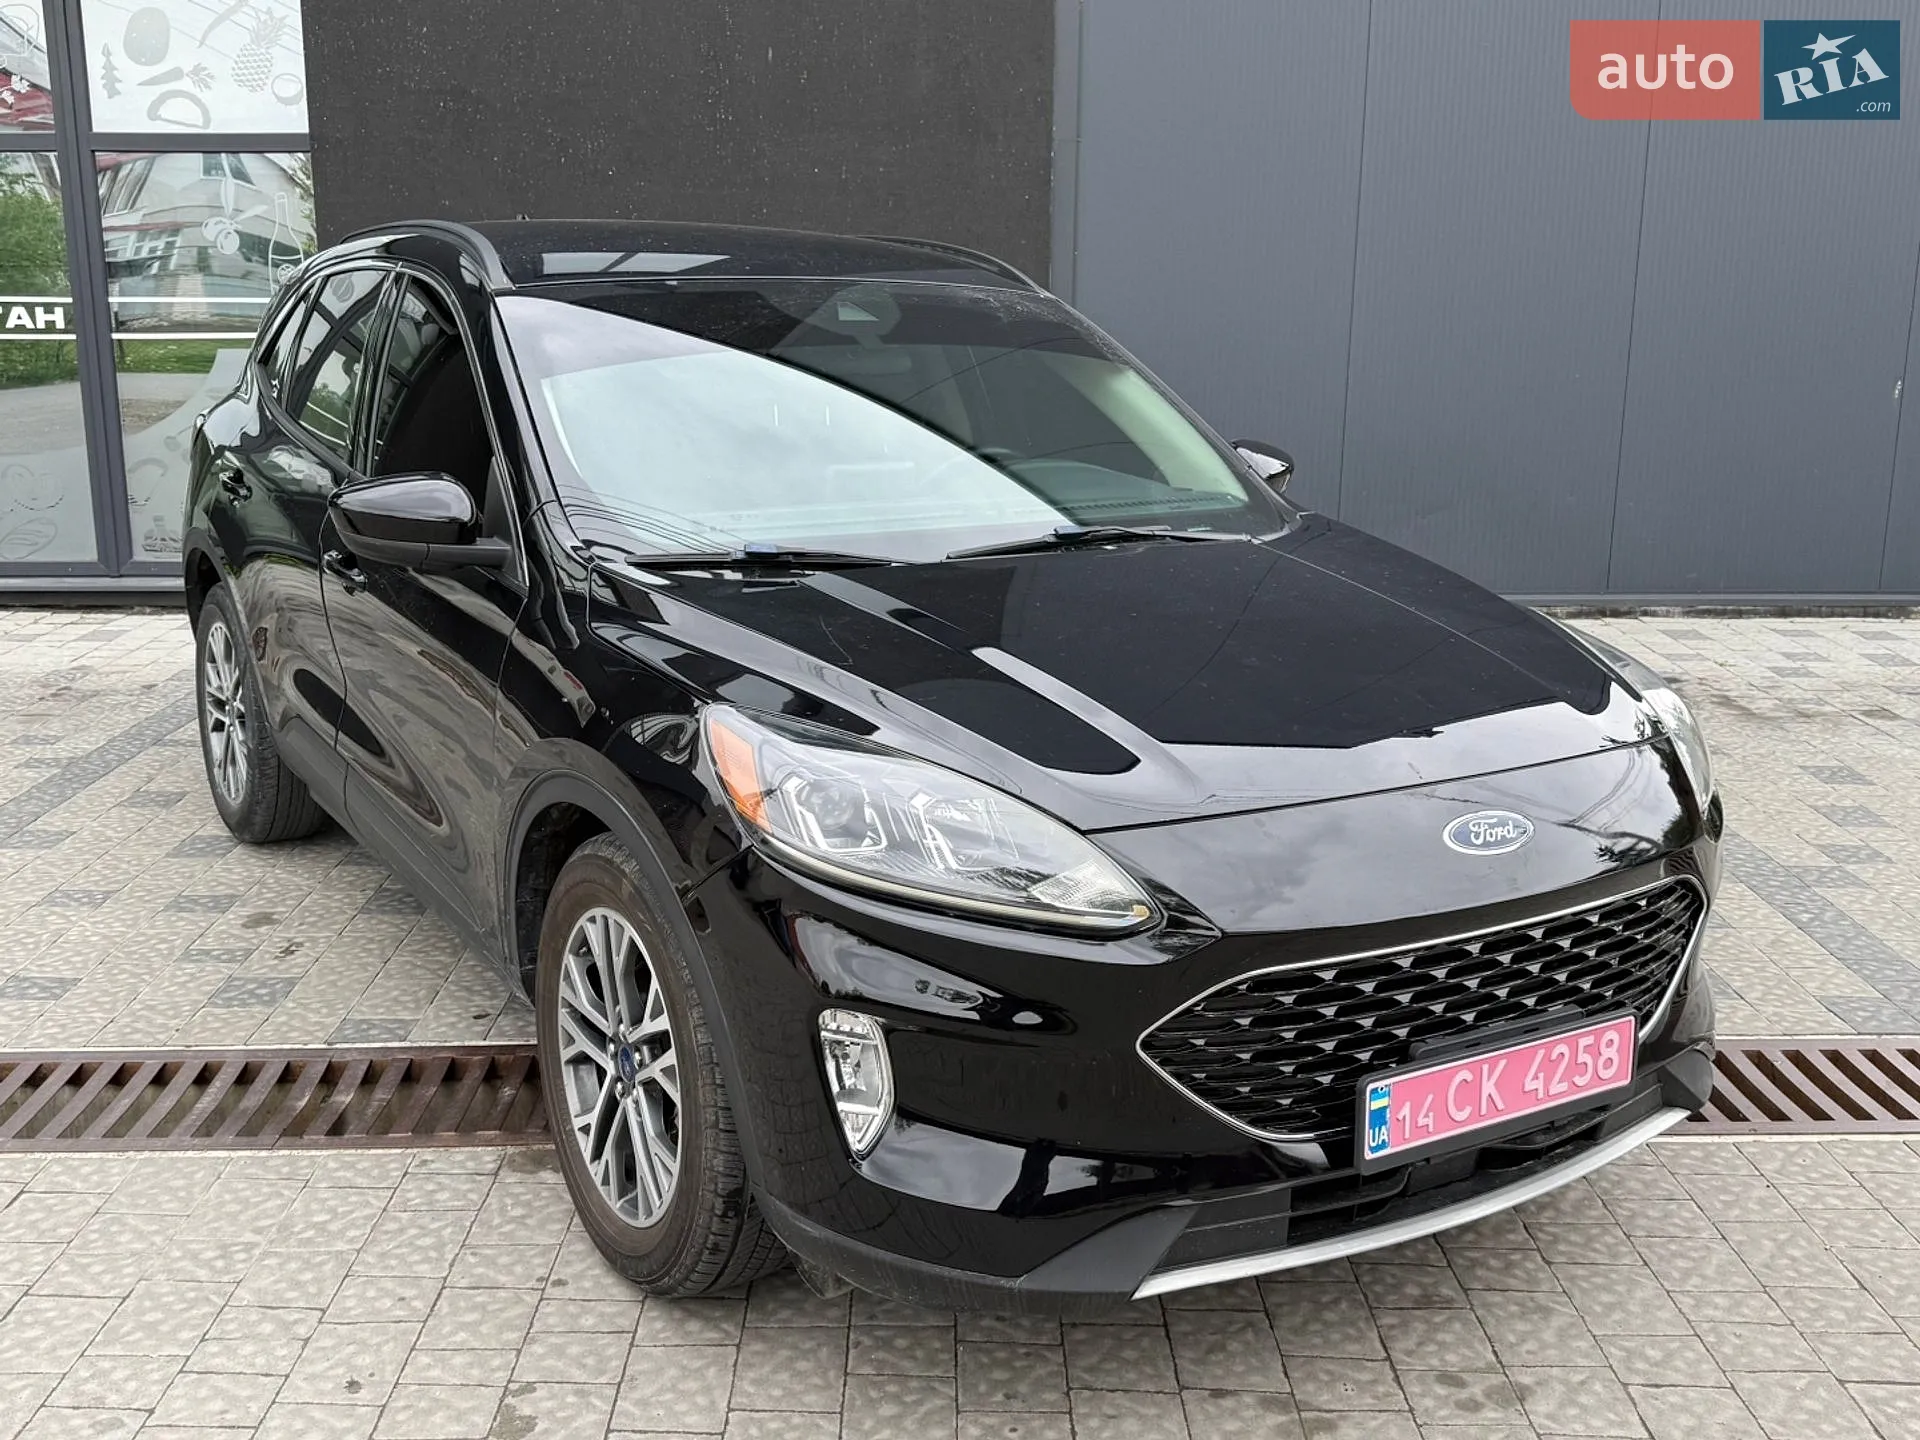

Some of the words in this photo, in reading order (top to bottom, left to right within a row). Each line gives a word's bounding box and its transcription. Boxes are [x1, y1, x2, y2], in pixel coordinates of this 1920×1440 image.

[0, 306, 65, 329] АН
[1468, 818, 1517, 845] Ford
[1396, 1094, 1435, 1139] 14
[1447, 1059, 1507, 1122] CK
[1522, 1029, 1620, 1100] 4258
[1369, 1125, 1388, 1147] UA
